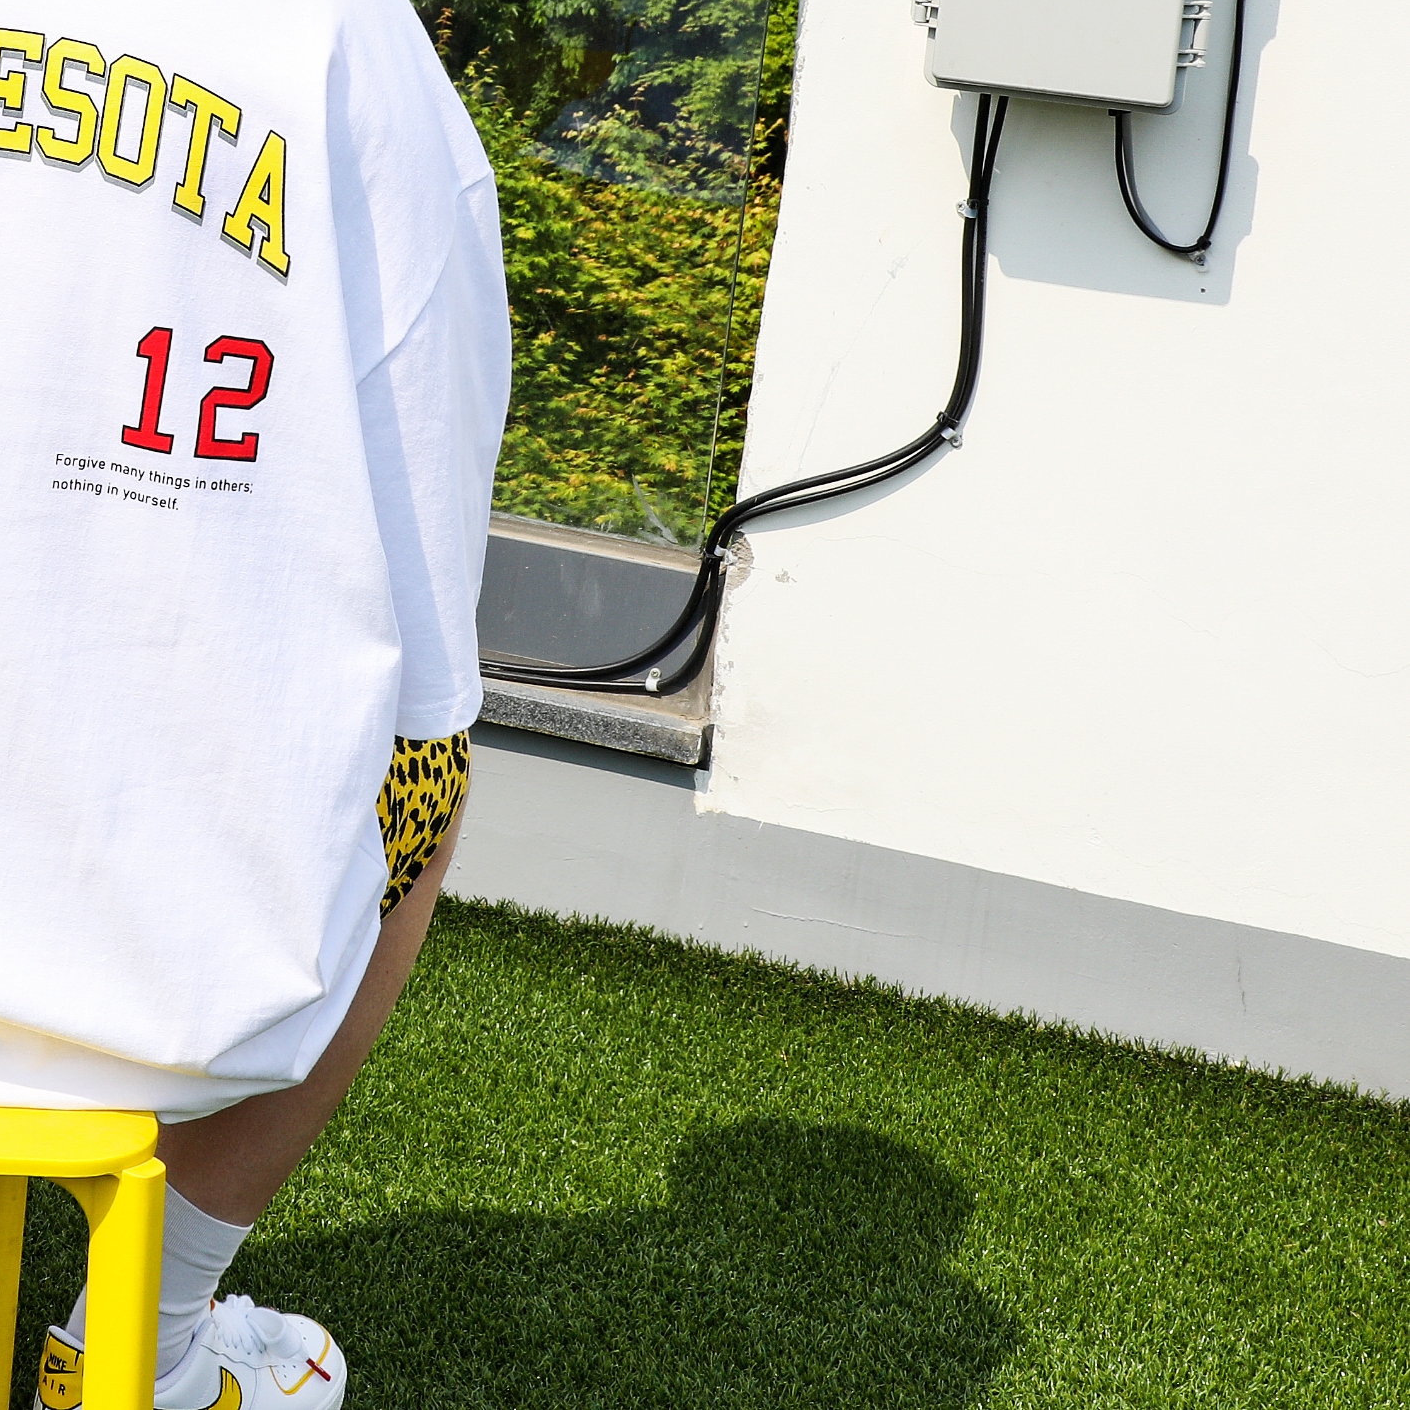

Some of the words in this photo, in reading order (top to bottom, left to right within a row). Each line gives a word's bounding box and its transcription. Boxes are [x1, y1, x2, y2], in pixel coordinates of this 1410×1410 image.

[121, 326, 275, 462] 12
[55, 453, 106, 471] Forgive
[110, 462, 146, 482] many
[148, 470, 191, 490] things
[195, 476, 207, 490] in
[210, 478, 254, 495] others;
[51, 478, 103, 496] nothing
[106, 481, 119, 496] in
[122, 485, 181, 511] yourself.
[48, 1352, 68, 1370] NIKE
[41, 1374, 66, 1396] AIR
